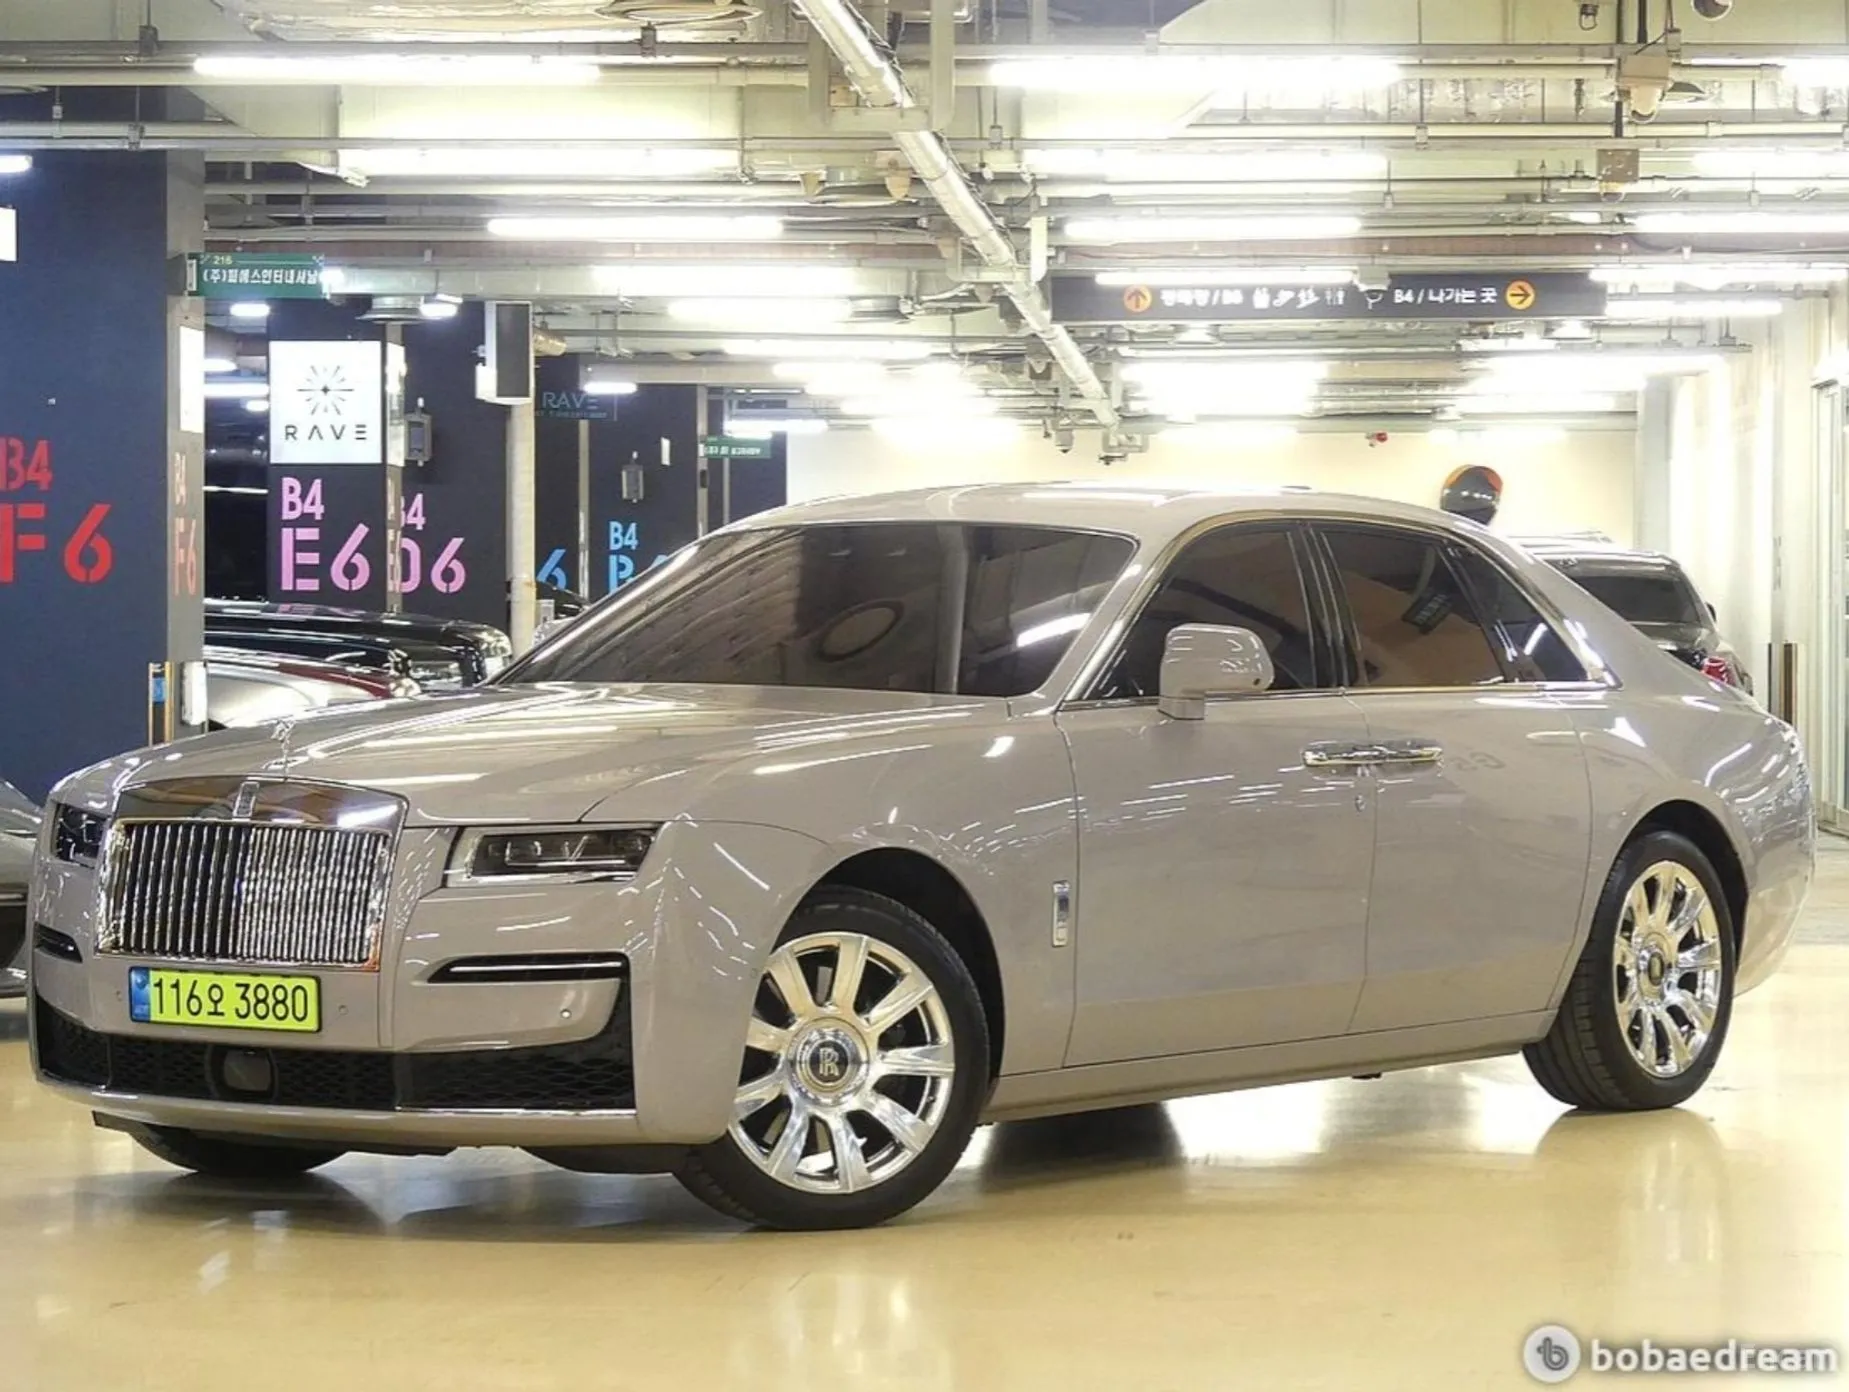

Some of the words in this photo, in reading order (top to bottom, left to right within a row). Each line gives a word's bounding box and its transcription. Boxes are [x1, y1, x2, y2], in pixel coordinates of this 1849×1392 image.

[1393, 288, 1415, 304] B4
[1428, 288, 1477, 304] 나가는
[1480, 287, 1498, 304] 곳
[284, 424, 367, 441] RAVE
[0, 436, 53, 492] B4
[281, 476, 325, 521] B4
[400, 493, 426, 531] 4
[609, 520, 638, 551] B4
[153, 977, 226, 1017] 116오
[234, 982, 309, 1023] 3880
